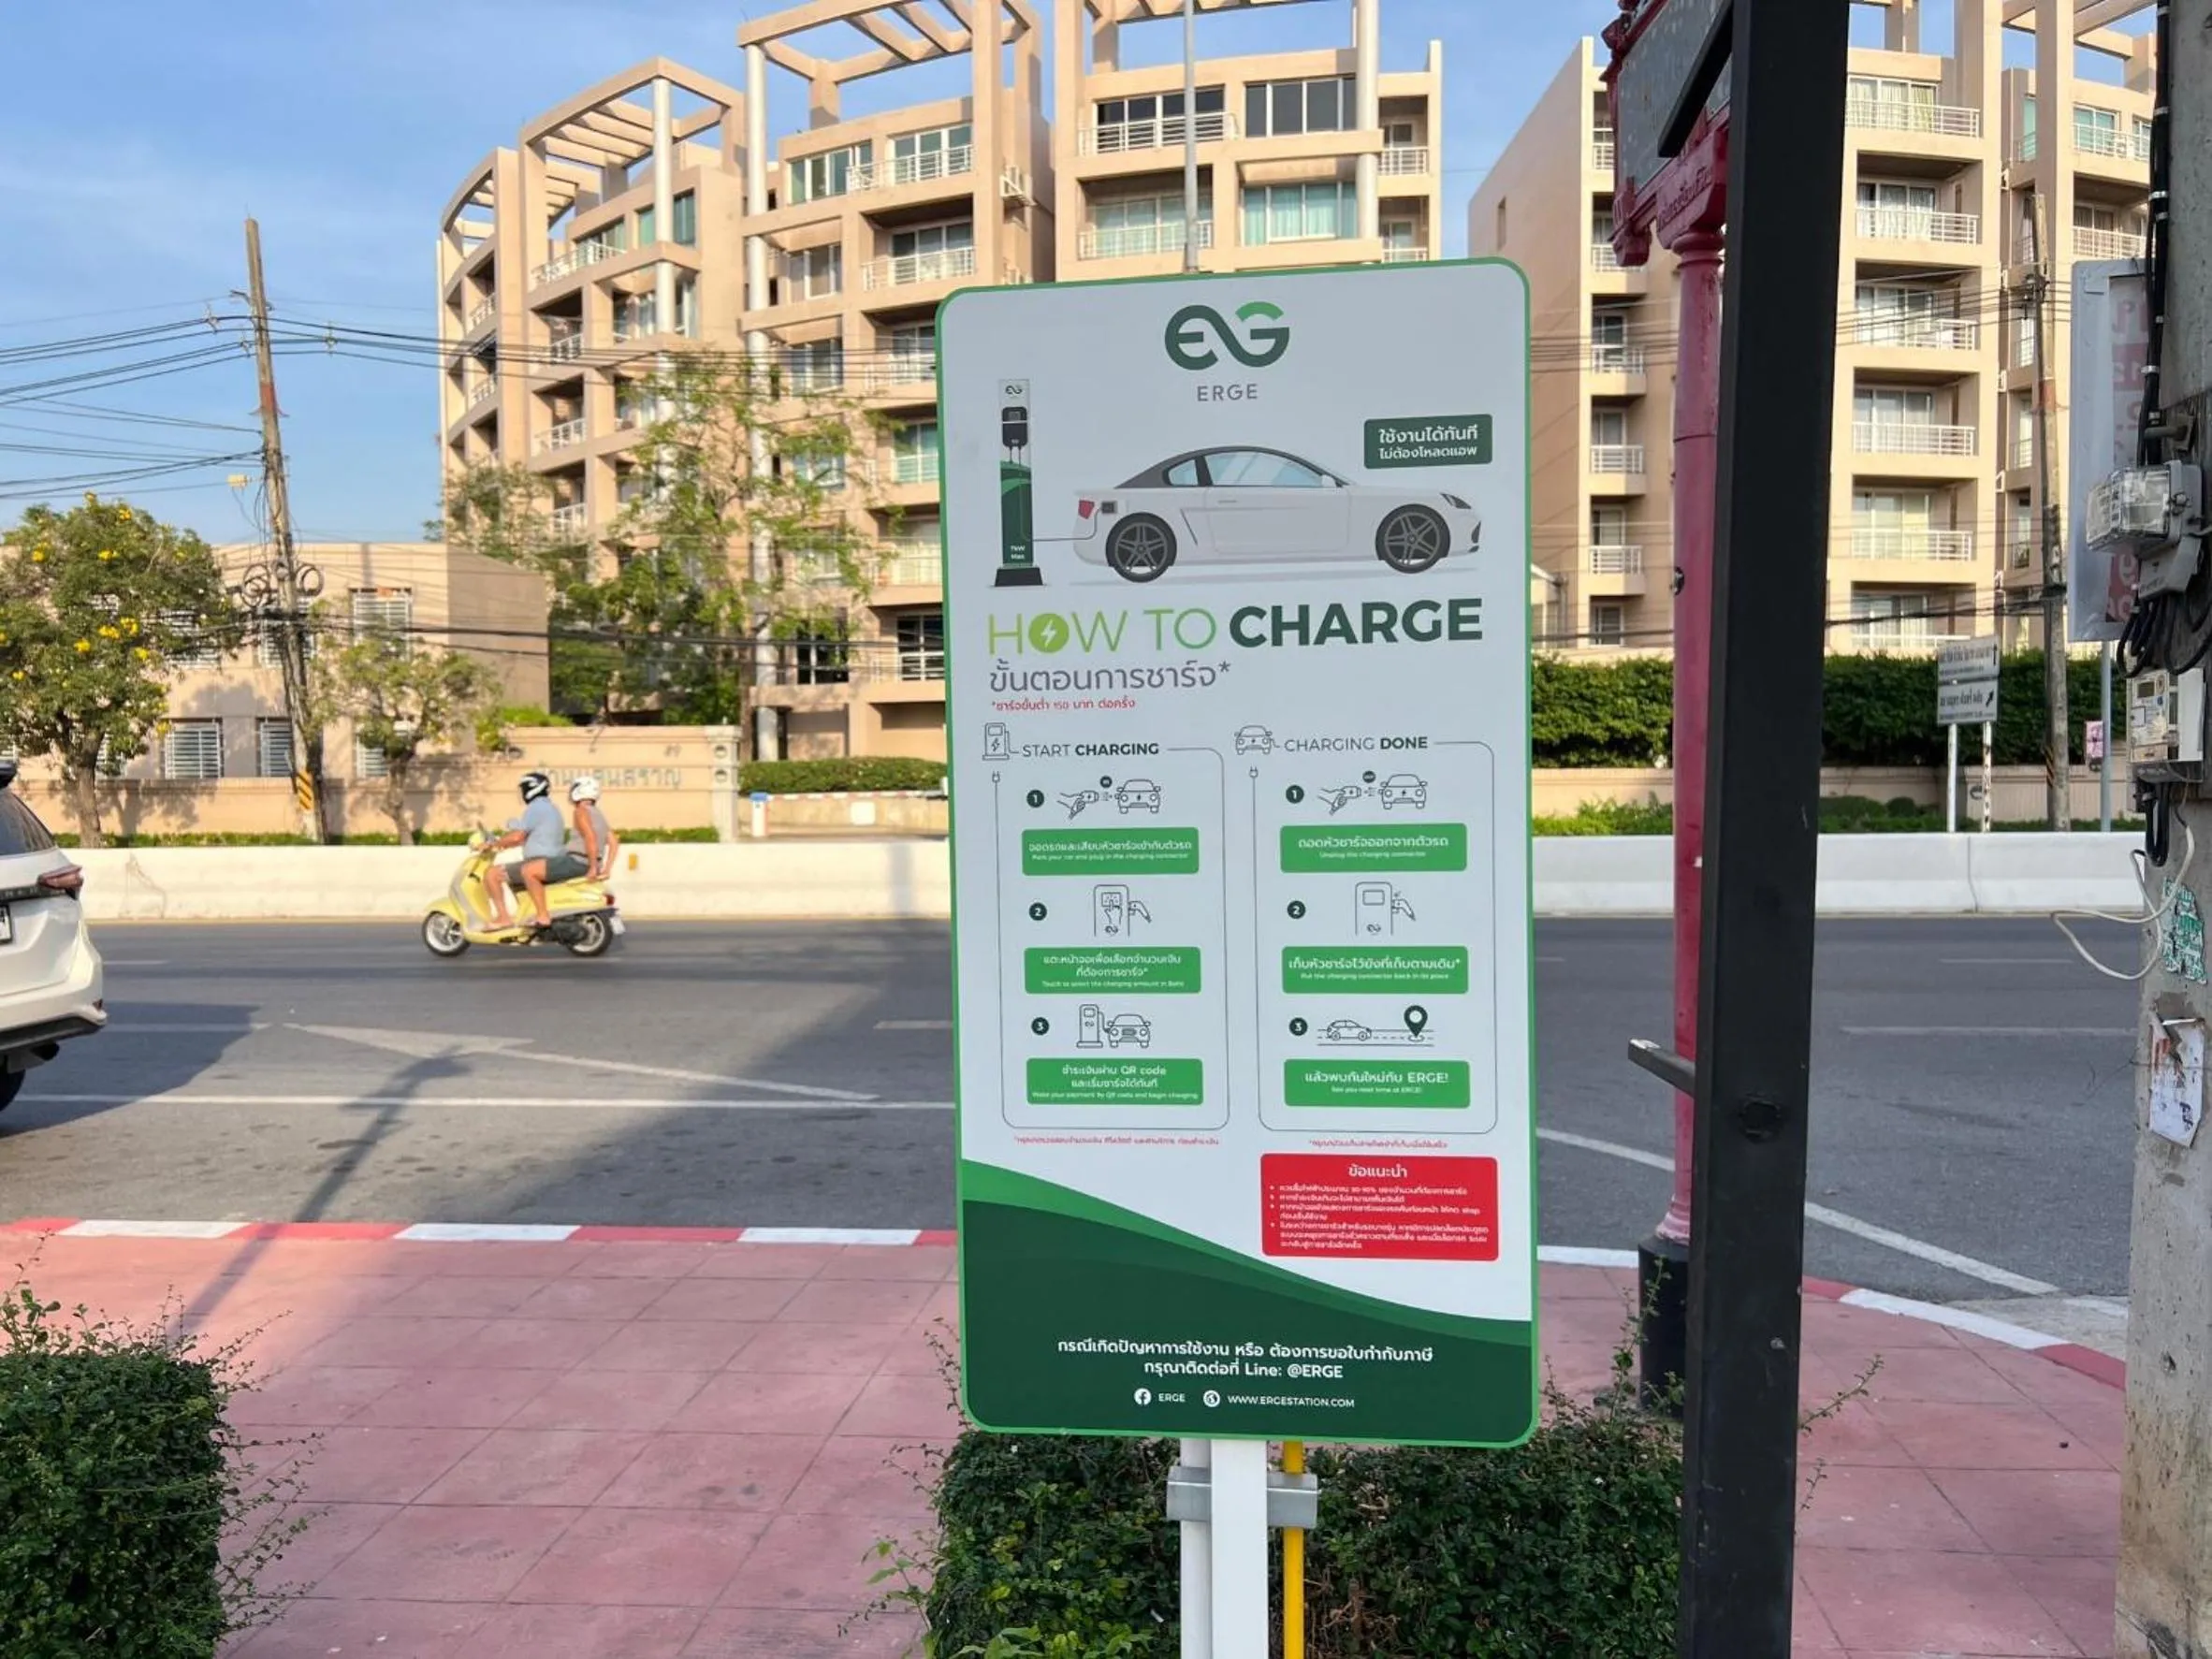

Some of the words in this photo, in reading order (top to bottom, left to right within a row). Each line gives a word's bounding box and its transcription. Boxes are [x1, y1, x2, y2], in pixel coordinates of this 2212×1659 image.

[1196, 383, 1259, 402] ERGE
[1377, 423, 1478, 444] ใช้งานได้ทันที
[1377, 444, 1478, 460] ไม่ต้องโหลดแอพ
[987, 609, 1129, 656] HOW
[1142, 606, 1217, 650] TO
[1228, 598, 1483, 649] CHARGE
[1072, 698, 1094, 710] บาท
[1098, 695, 1136, 710] ต่อครั้ง
[1022, 744, 1070, 758] START
[1074, 742, 1160, 757] CHARGING
[1284, 737, 1375, 752] CHARGING
[1379, 735, 1428, 750] DONE
[1298, 835, 1449, 850] ถอดหัวชาร์จออกจากตัวรถ
[1061, 1064, 1117, 1076] ชำระเงินผ่าน
[1119, 1065, 1137, 1077] QR
[1140, 1064, 1167, 1076] code
[1304, 1070, 1403, 1084] แล้วพบกันใหม่กับ
[1347, 1163, 1408, 1178] ข้อแนะนำ
[1056, 1338, 1230, 1357] กรณีเกิดปัญหาการใช้งาน
[1234, 1341, 1265, 1358] หรือ
[1269, 1343, 1433, 1363] ต้องการขอใบกำกับภาษี
[1143, 1358, 1241, 1378] กรุณาติดต่อที่
[1244, 1362, 1283, 1377] Line:
[1286, 1363, 1344, 1379] @ERGE
[1157, 1392, 1186, 1404] ERGE
[1227, 1393, 1356, 1408] WWW.ERGESTATION.COM
